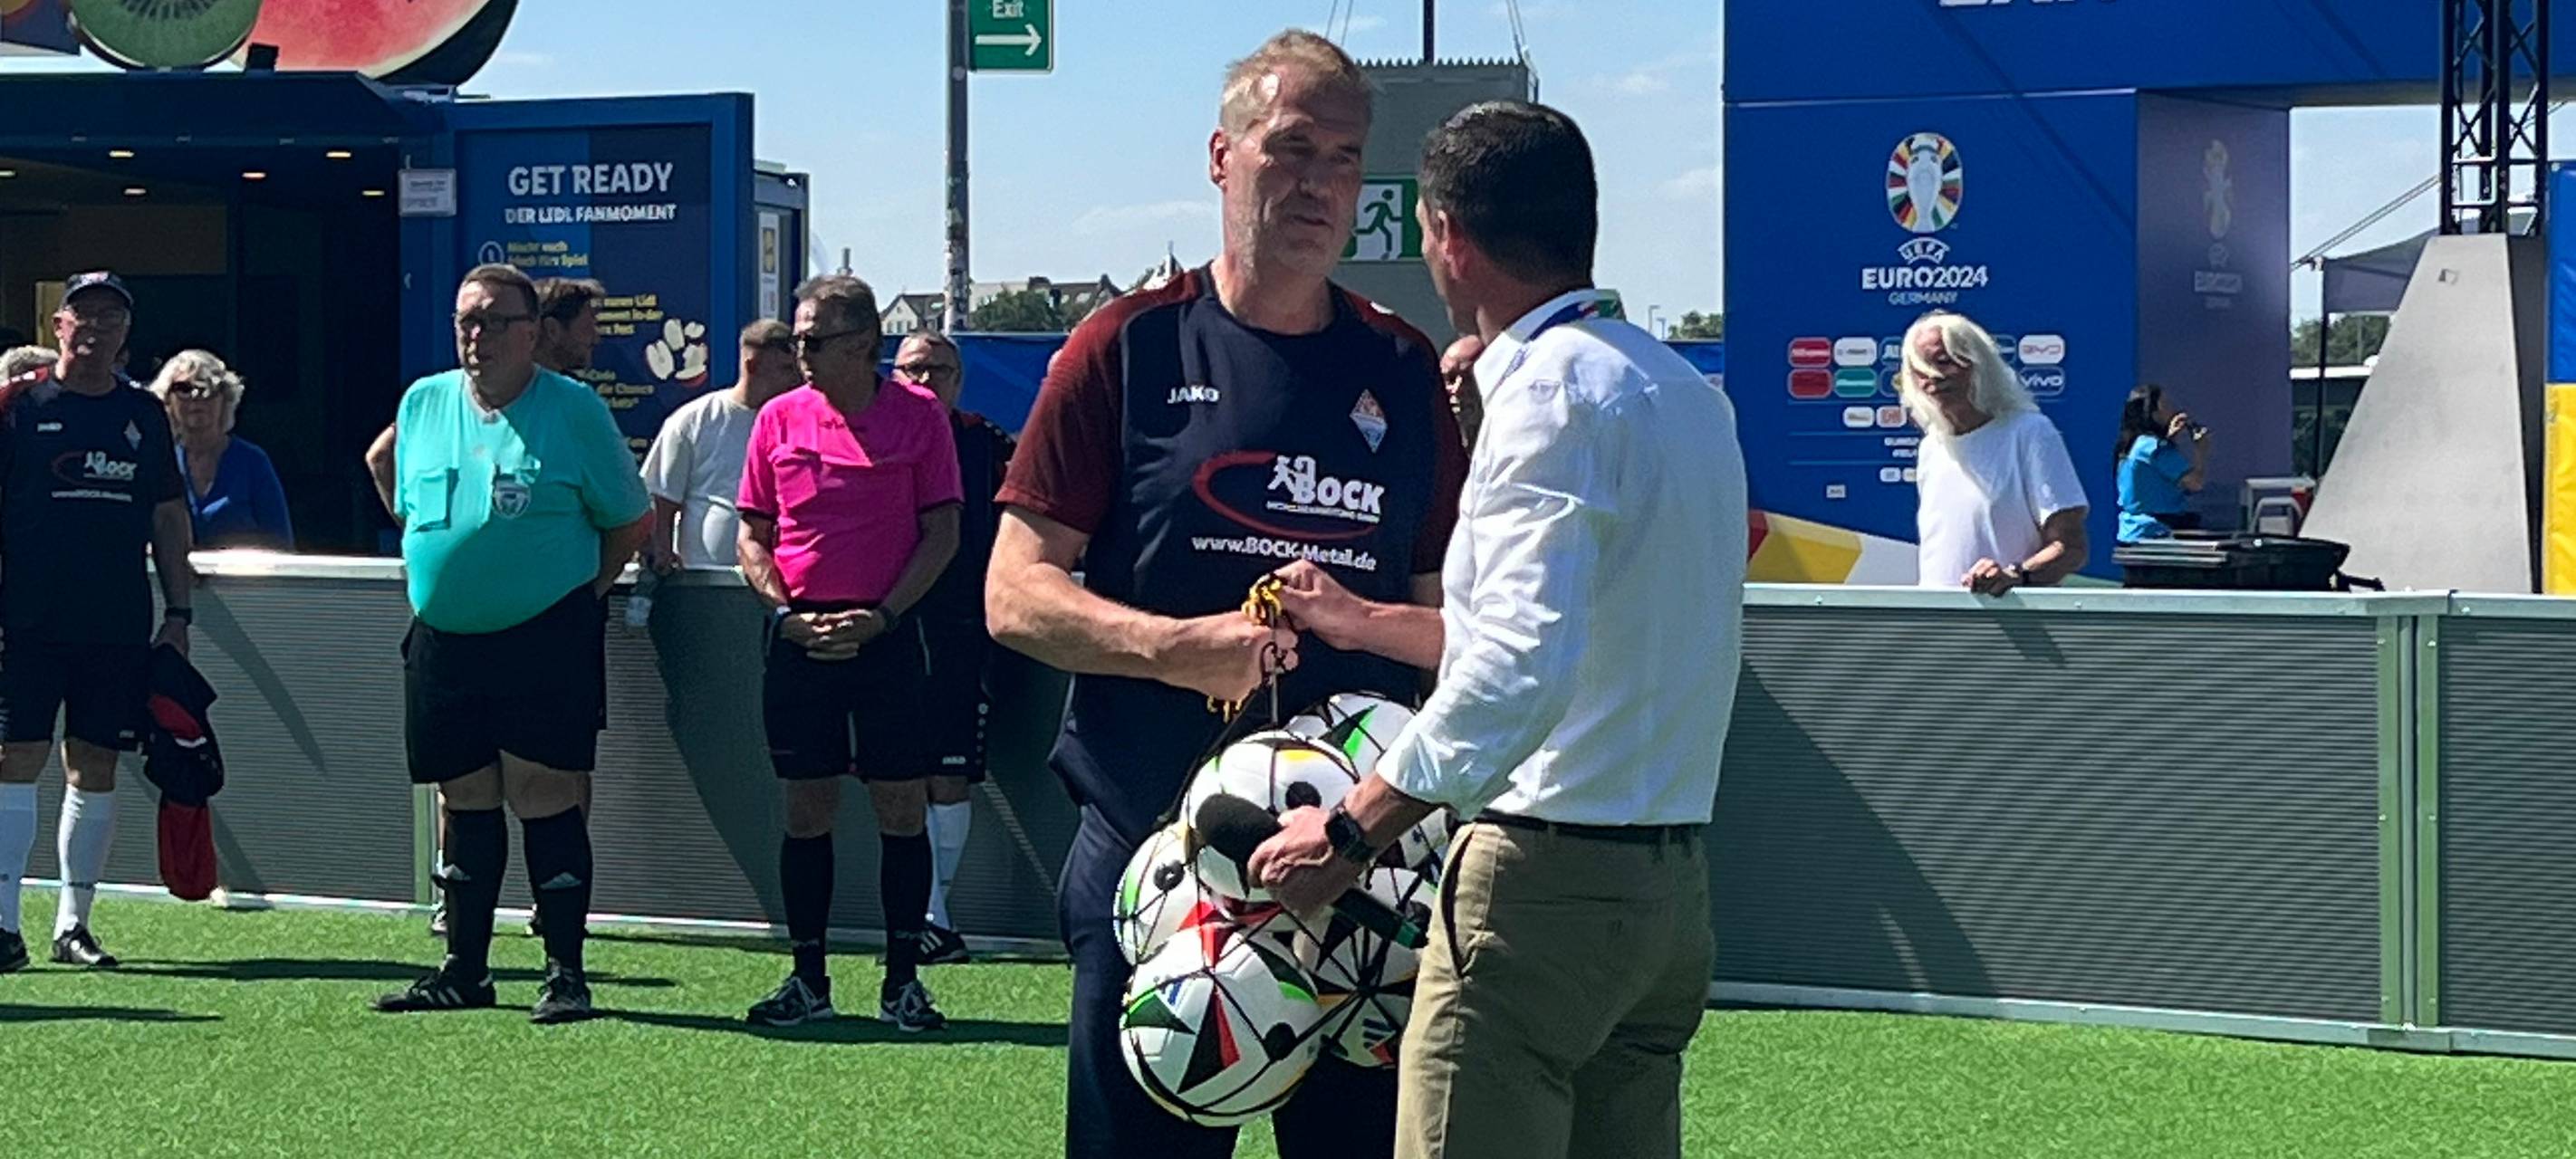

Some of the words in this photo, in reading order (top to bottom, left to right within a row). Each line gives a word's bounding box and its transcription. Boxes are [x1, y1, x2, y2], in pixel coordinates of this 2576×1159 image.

[993, 0, 1024, 18] Exit
[508, 165, 566, 196] GET
[572, 162, 674, 194] READY
[505, 208, 536, 224] DER
[538, 207, 572, 224] LIDL
[575, 204, 677, 222] FANMOMENT
[1901, 241, 1946, 262] UEFA
[1888, 291, 1959, 306] GERMANY
[1167, 385, 1220, 404] JAKO
[1293, 473, 1384, 514] BOCK
